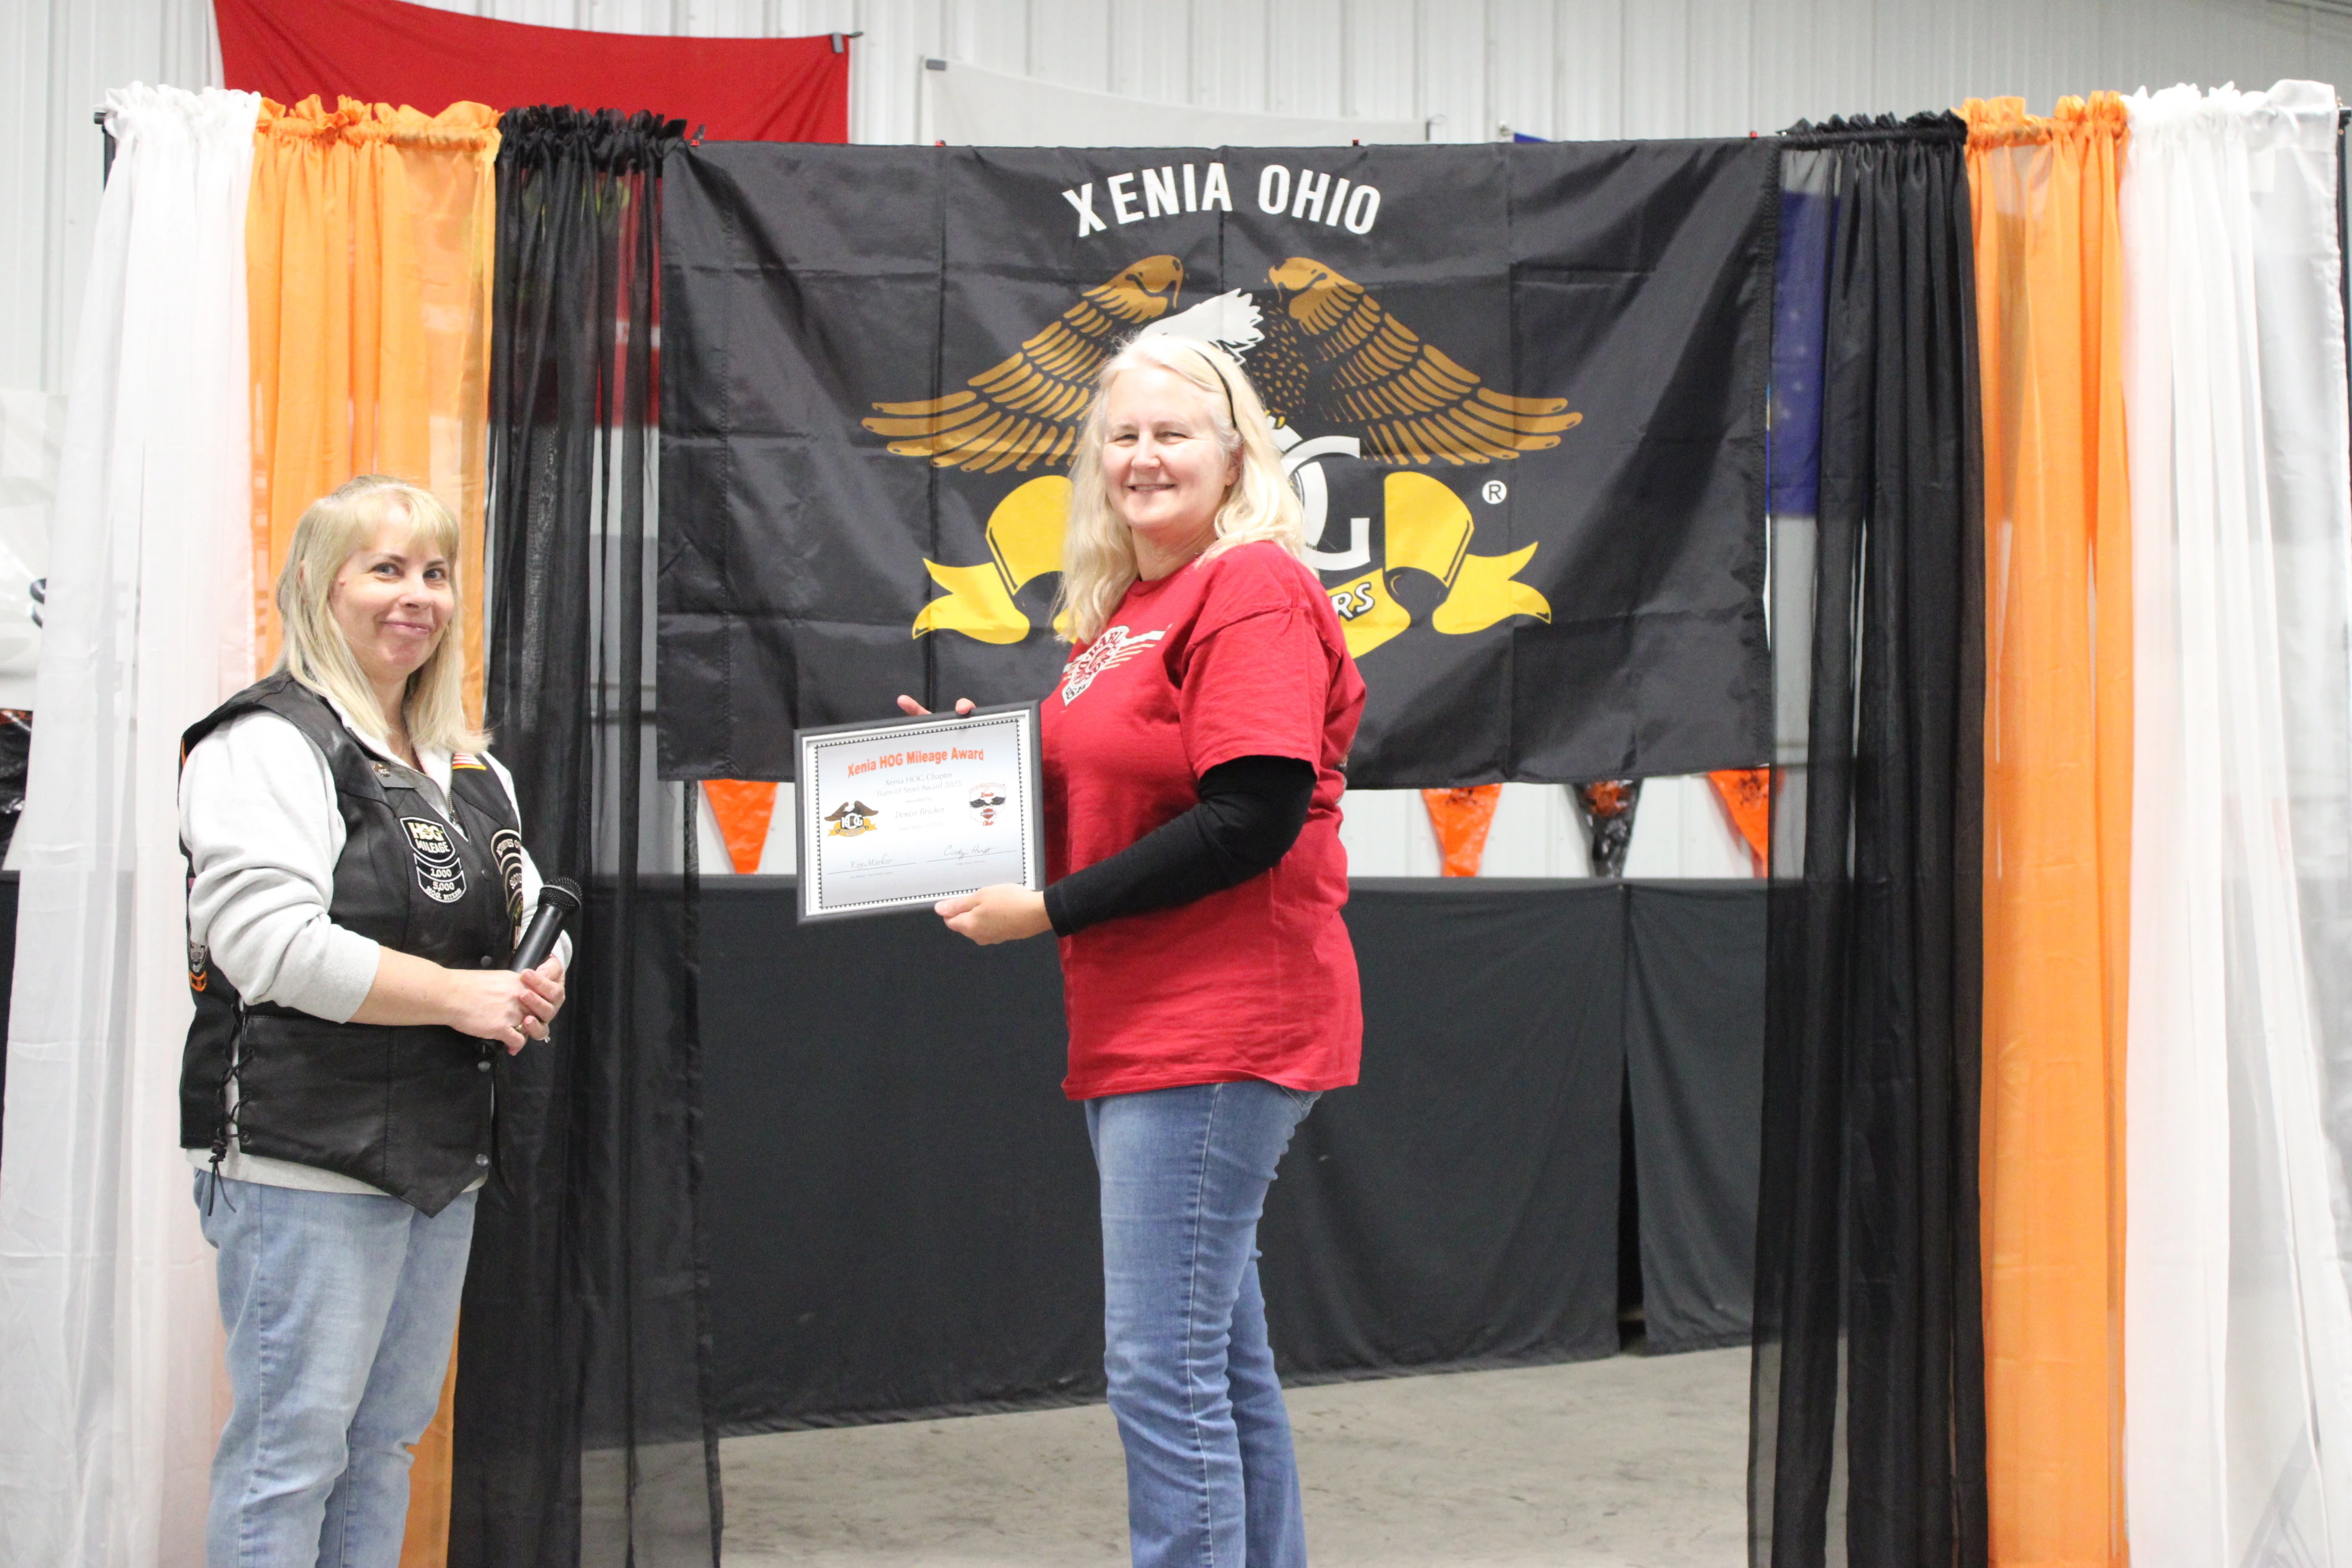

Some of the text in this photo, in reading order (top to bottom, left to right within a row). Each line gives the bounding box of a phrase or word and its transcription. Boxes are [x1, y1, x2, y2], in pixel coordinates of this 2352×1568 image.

[1062, 162, 1381, 237] XENIA OHIO
[847, 747, 984, 778] Xenia HOG Mileage Award
[885, 772, 953, 786] Xenia HOG Chapter
[903, 785, 919, 793] Steel
[921, 782, 943, 791] Award
[945, 780, 962, 789] 2025
[894, 809, 917, 819] Denise
[407, 822, 445, 841] HOG
[414, 839, 450, 854] MILEAGE
[430, 868, 452, 878] 1,000
[433, 881, 455, 892] 5,000
